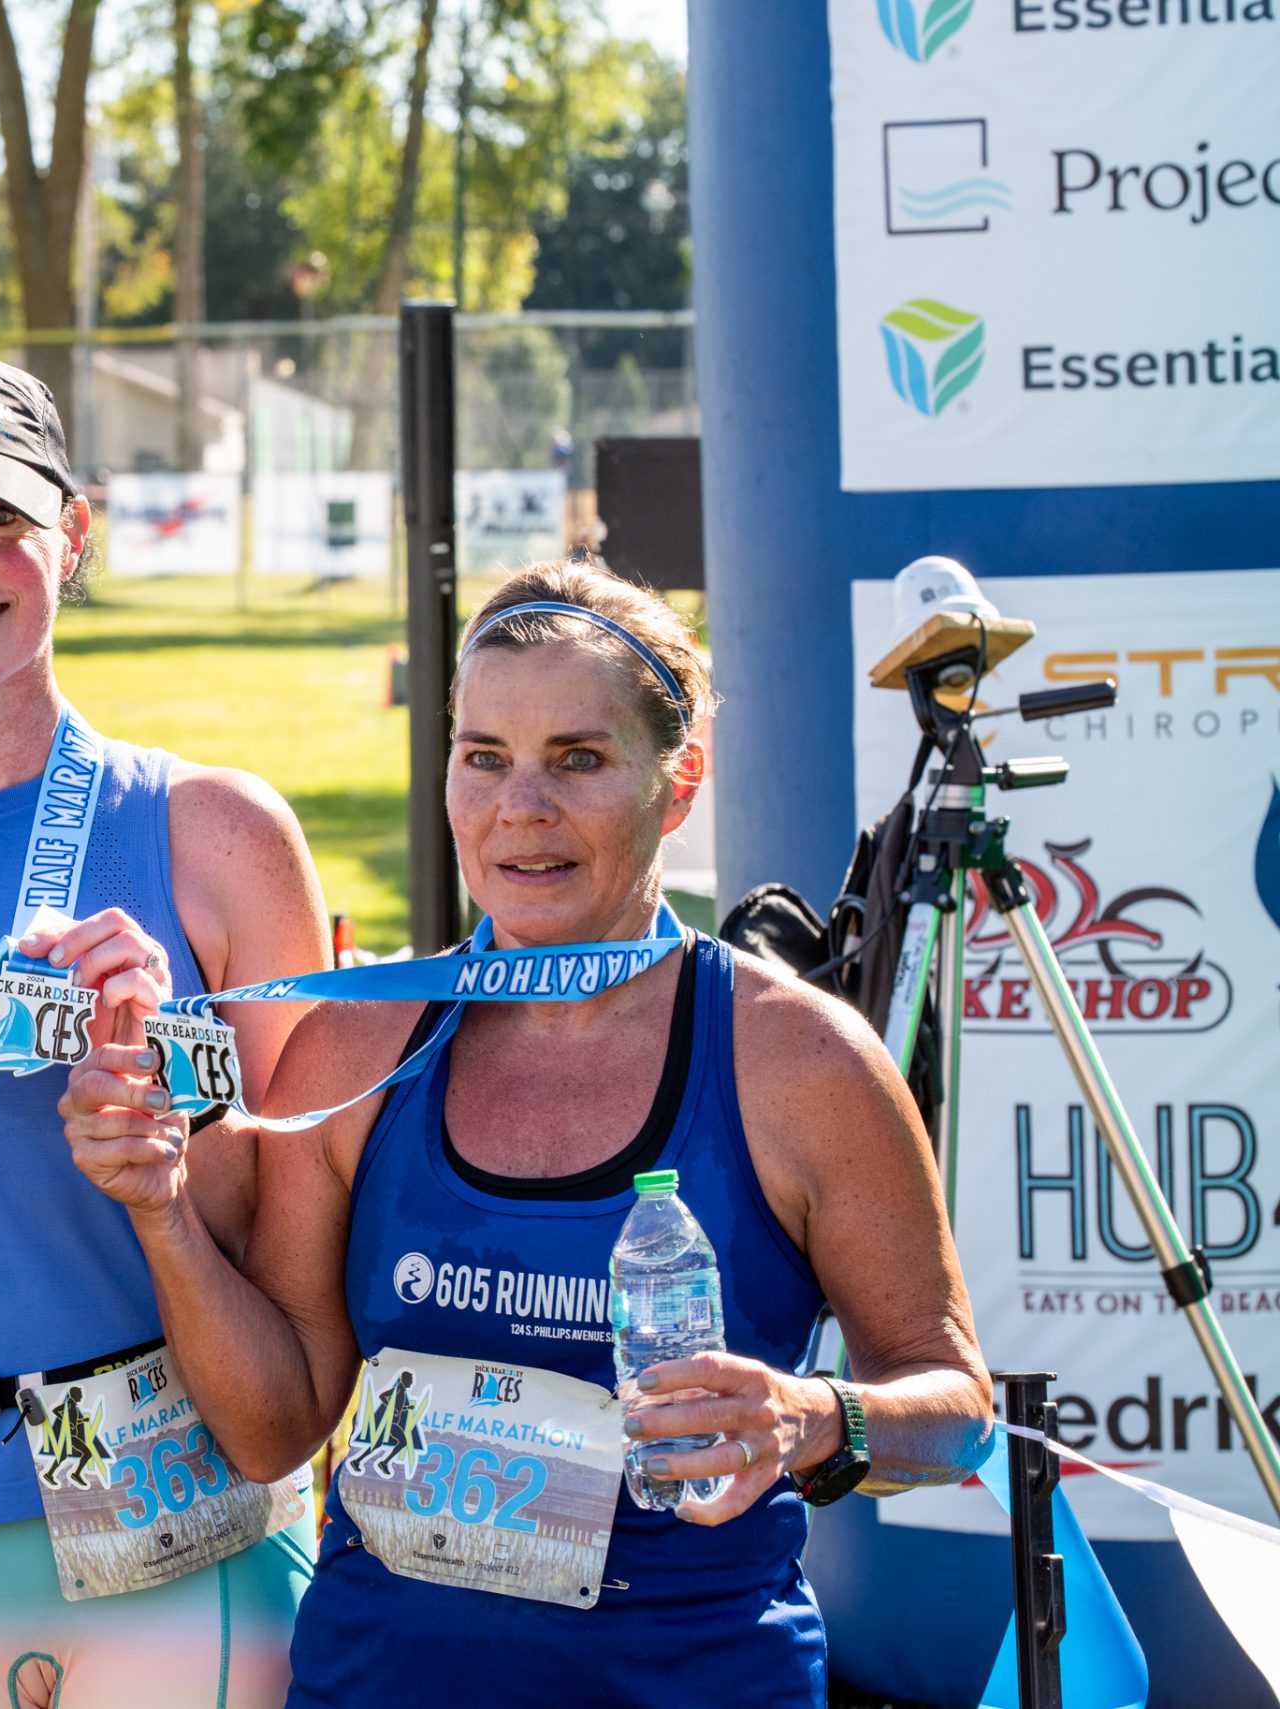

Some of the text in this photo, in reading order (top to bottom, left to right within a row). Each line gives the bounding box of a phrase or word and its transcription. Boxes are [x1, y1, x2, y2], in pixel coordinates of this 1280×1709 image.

[1022, 335, 1280, 390] Essentia
[1043, 709, 1280, 742] CHIROP
[24, 838, 79, 907] HALF
[26, 975, 45, 983] 2024
[452, 948, 652, 996] MARATHON
[17, 982, 96, 1005] BEARDSLEY
[1068, 977, 1212, 1021] HOP
[145, 1020, 228, 1043] DICK BEARDSLEY
[1015, 1104, 1262, 1261] HUB
[435, 1262, 492, 1312] 605
[495, 1269, 614, 1325] RUNNIN
[1023, 1290, 1085, 1314] EATS
[1096, 1292, 1142, 1314] ON
[510, 1323, 525, 1335] 124
[534, 1325, 571, 1340] PHILLIPS
[571, 1329, 605, 1342] AVENUE
[474, 1364, 490, 1373] DICK
[458, 1414, 585, 1451] MARATHON
[109, 1422, 230, 1530] 363
[404, 1442, 549, 1535] 362
[143, 1543, 197, 1569] Essentia Health
[412, 1550, 466, 1567] Essentia Health
[474, 1560, 520, 1576] Project 412
